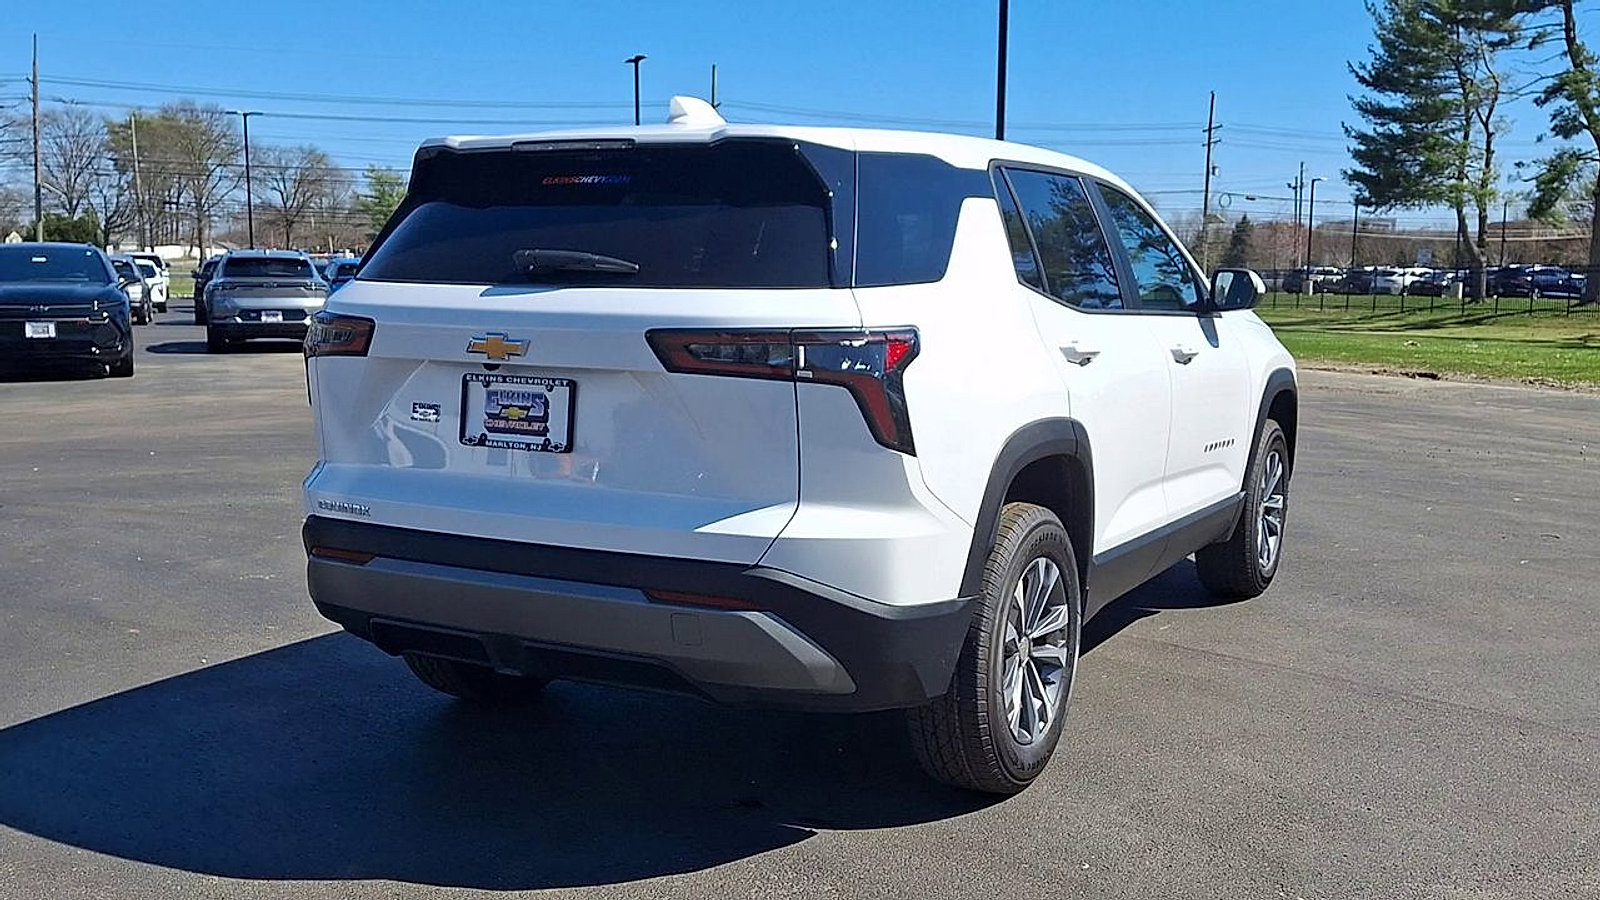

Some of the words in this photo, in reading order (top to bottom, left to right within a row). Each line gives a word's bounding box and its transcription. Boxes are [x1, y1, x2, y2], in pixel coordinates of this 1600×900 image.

[466, 374, 503, 383] ELKINS
[506, 376, 569, 386] CHEVROLET
[530, 443, 542, 451] NJ
